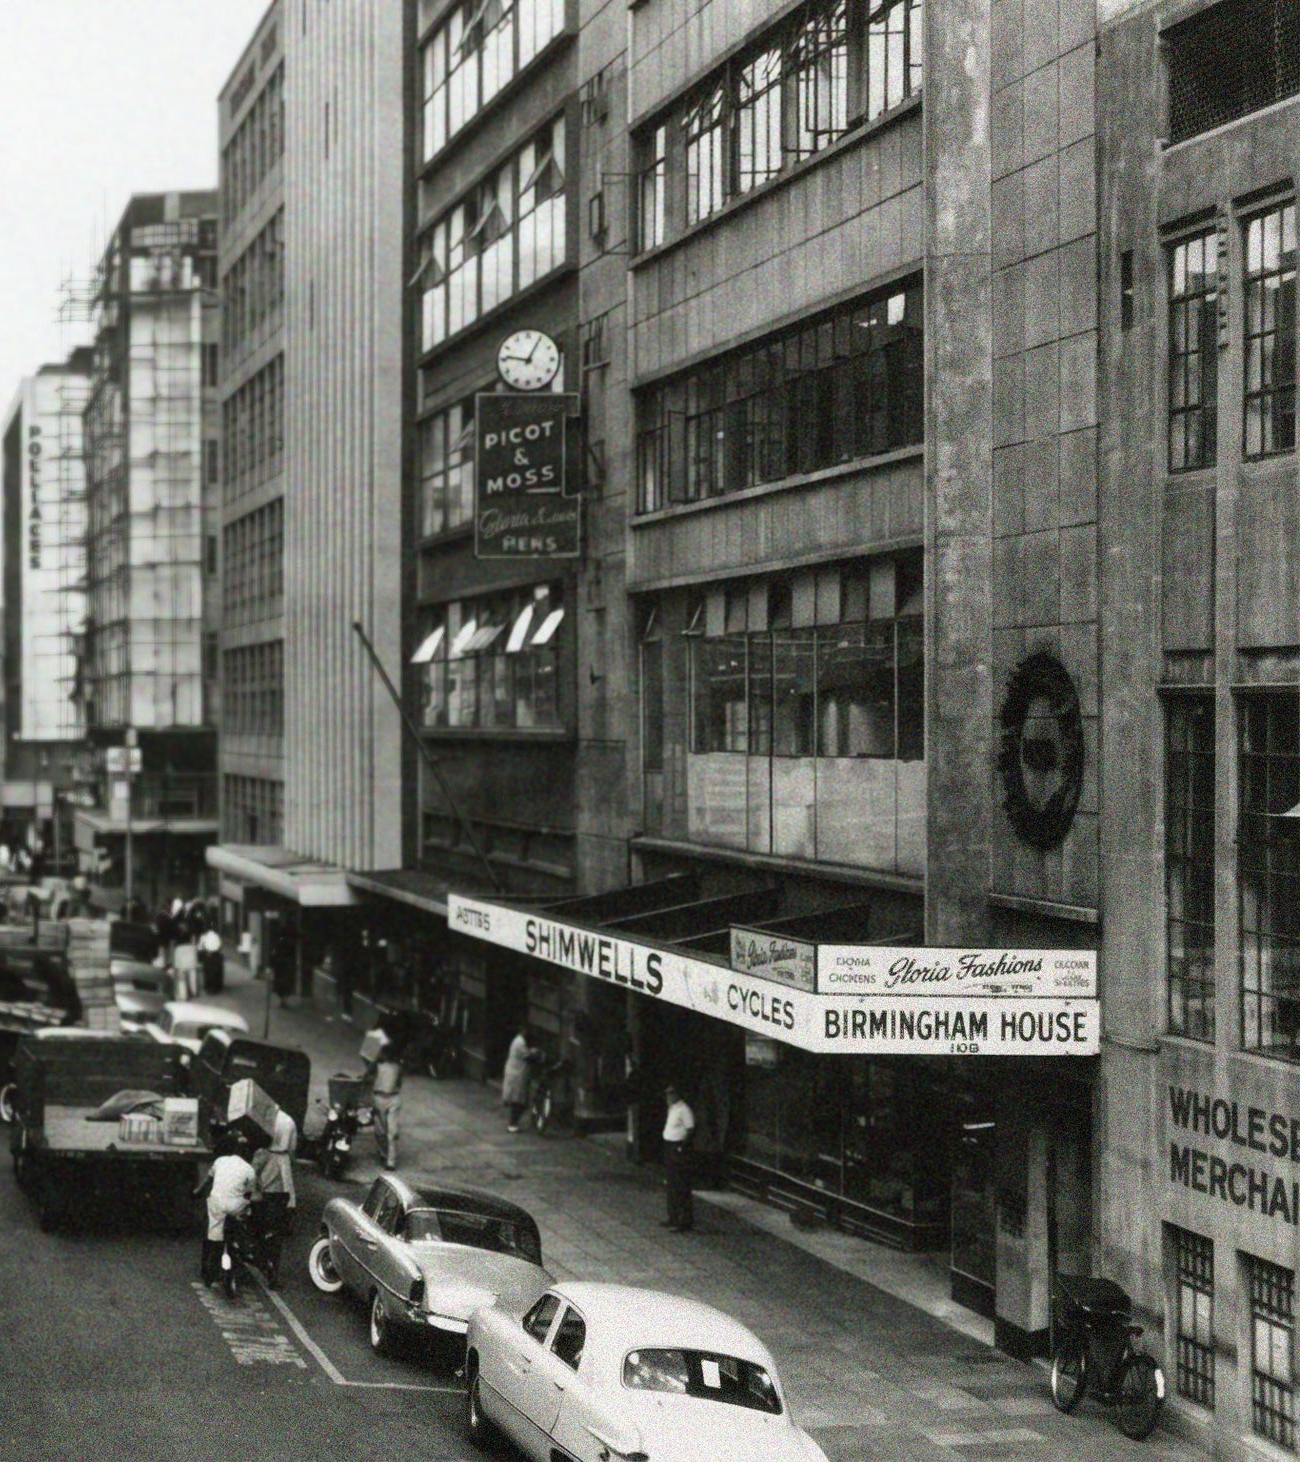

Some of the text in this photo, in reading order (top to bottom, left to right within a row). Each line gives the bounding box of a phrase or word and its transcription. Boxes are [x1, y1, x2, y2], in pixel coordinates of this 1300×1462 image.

[485, 420, 554, 449] PICOT
[513, 448, 530, 466] &
[487, 465, 554, 494] MOSS
[525, 919, 664, 996] SHIMWELLS
[884, 955, 952, 989] Gloria
[955, 952, 1043, 980] Fashions
[727, 983, 796, 1031] CYCLES
[824, 1009, 1088, 1043] BIRMINGHAM HOUSE
